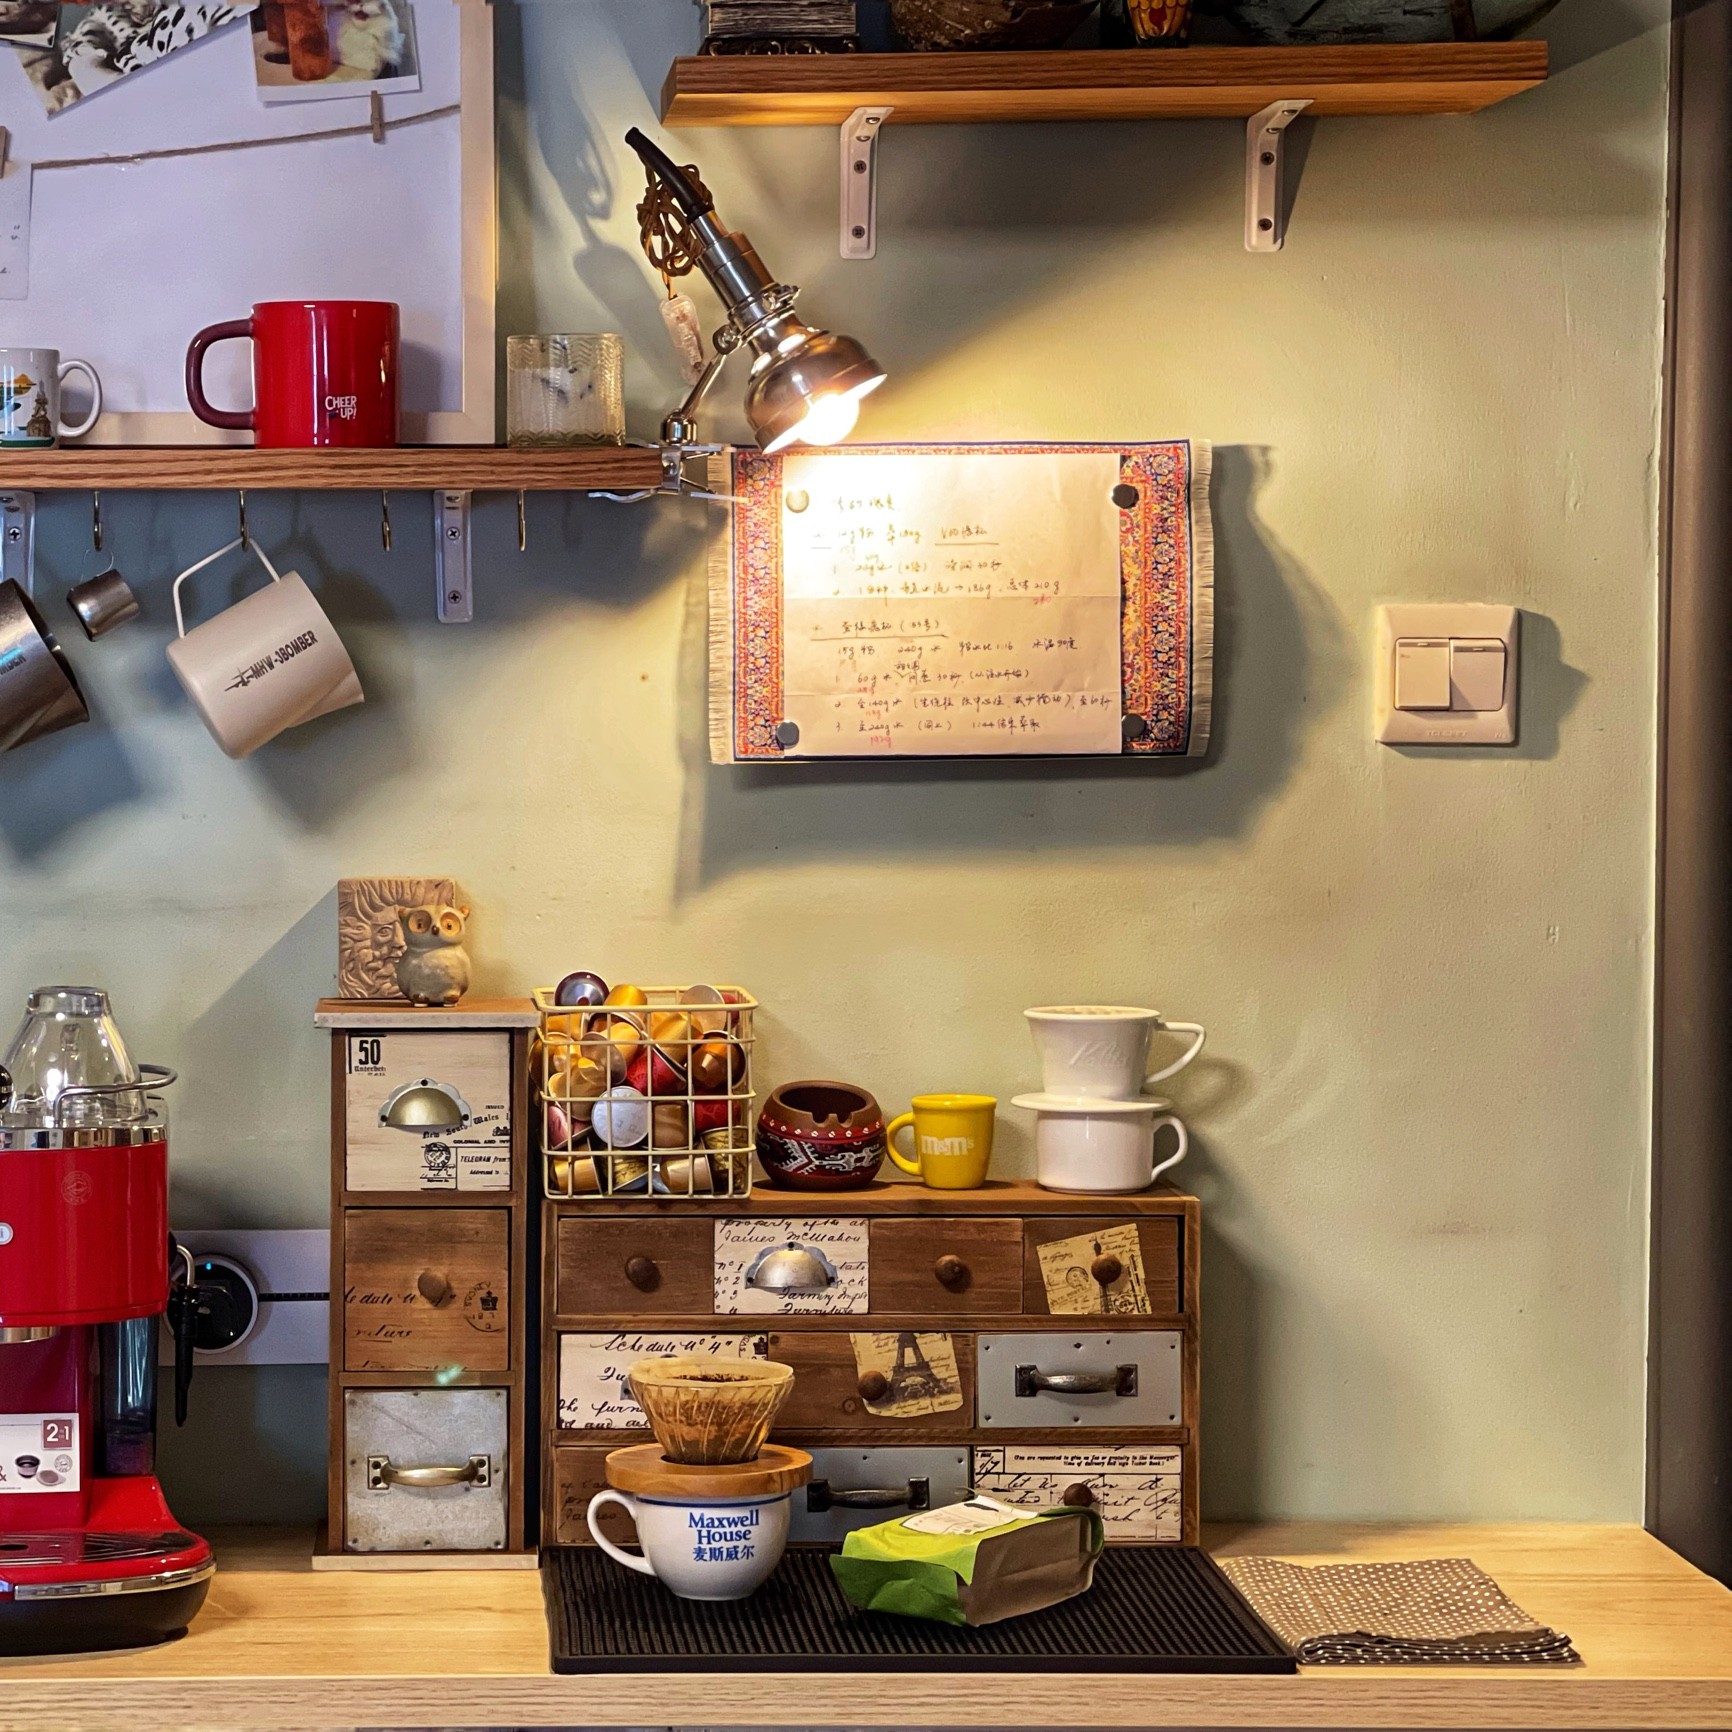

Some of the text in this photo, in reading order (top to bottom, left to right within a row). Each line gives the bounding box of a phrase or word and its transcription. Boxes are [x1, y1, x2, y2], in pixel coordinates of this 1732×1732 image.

[325, 396, 357, 411] CHEER
[340, 408, 357, 421] UP!
[358, 1038, 381, 1066] 50
[688, 1509, 759, 1528] Maxwell
[697, 1529, 752, 1545] House
[693, 1545, 755, 1562] 麦斯威尔
